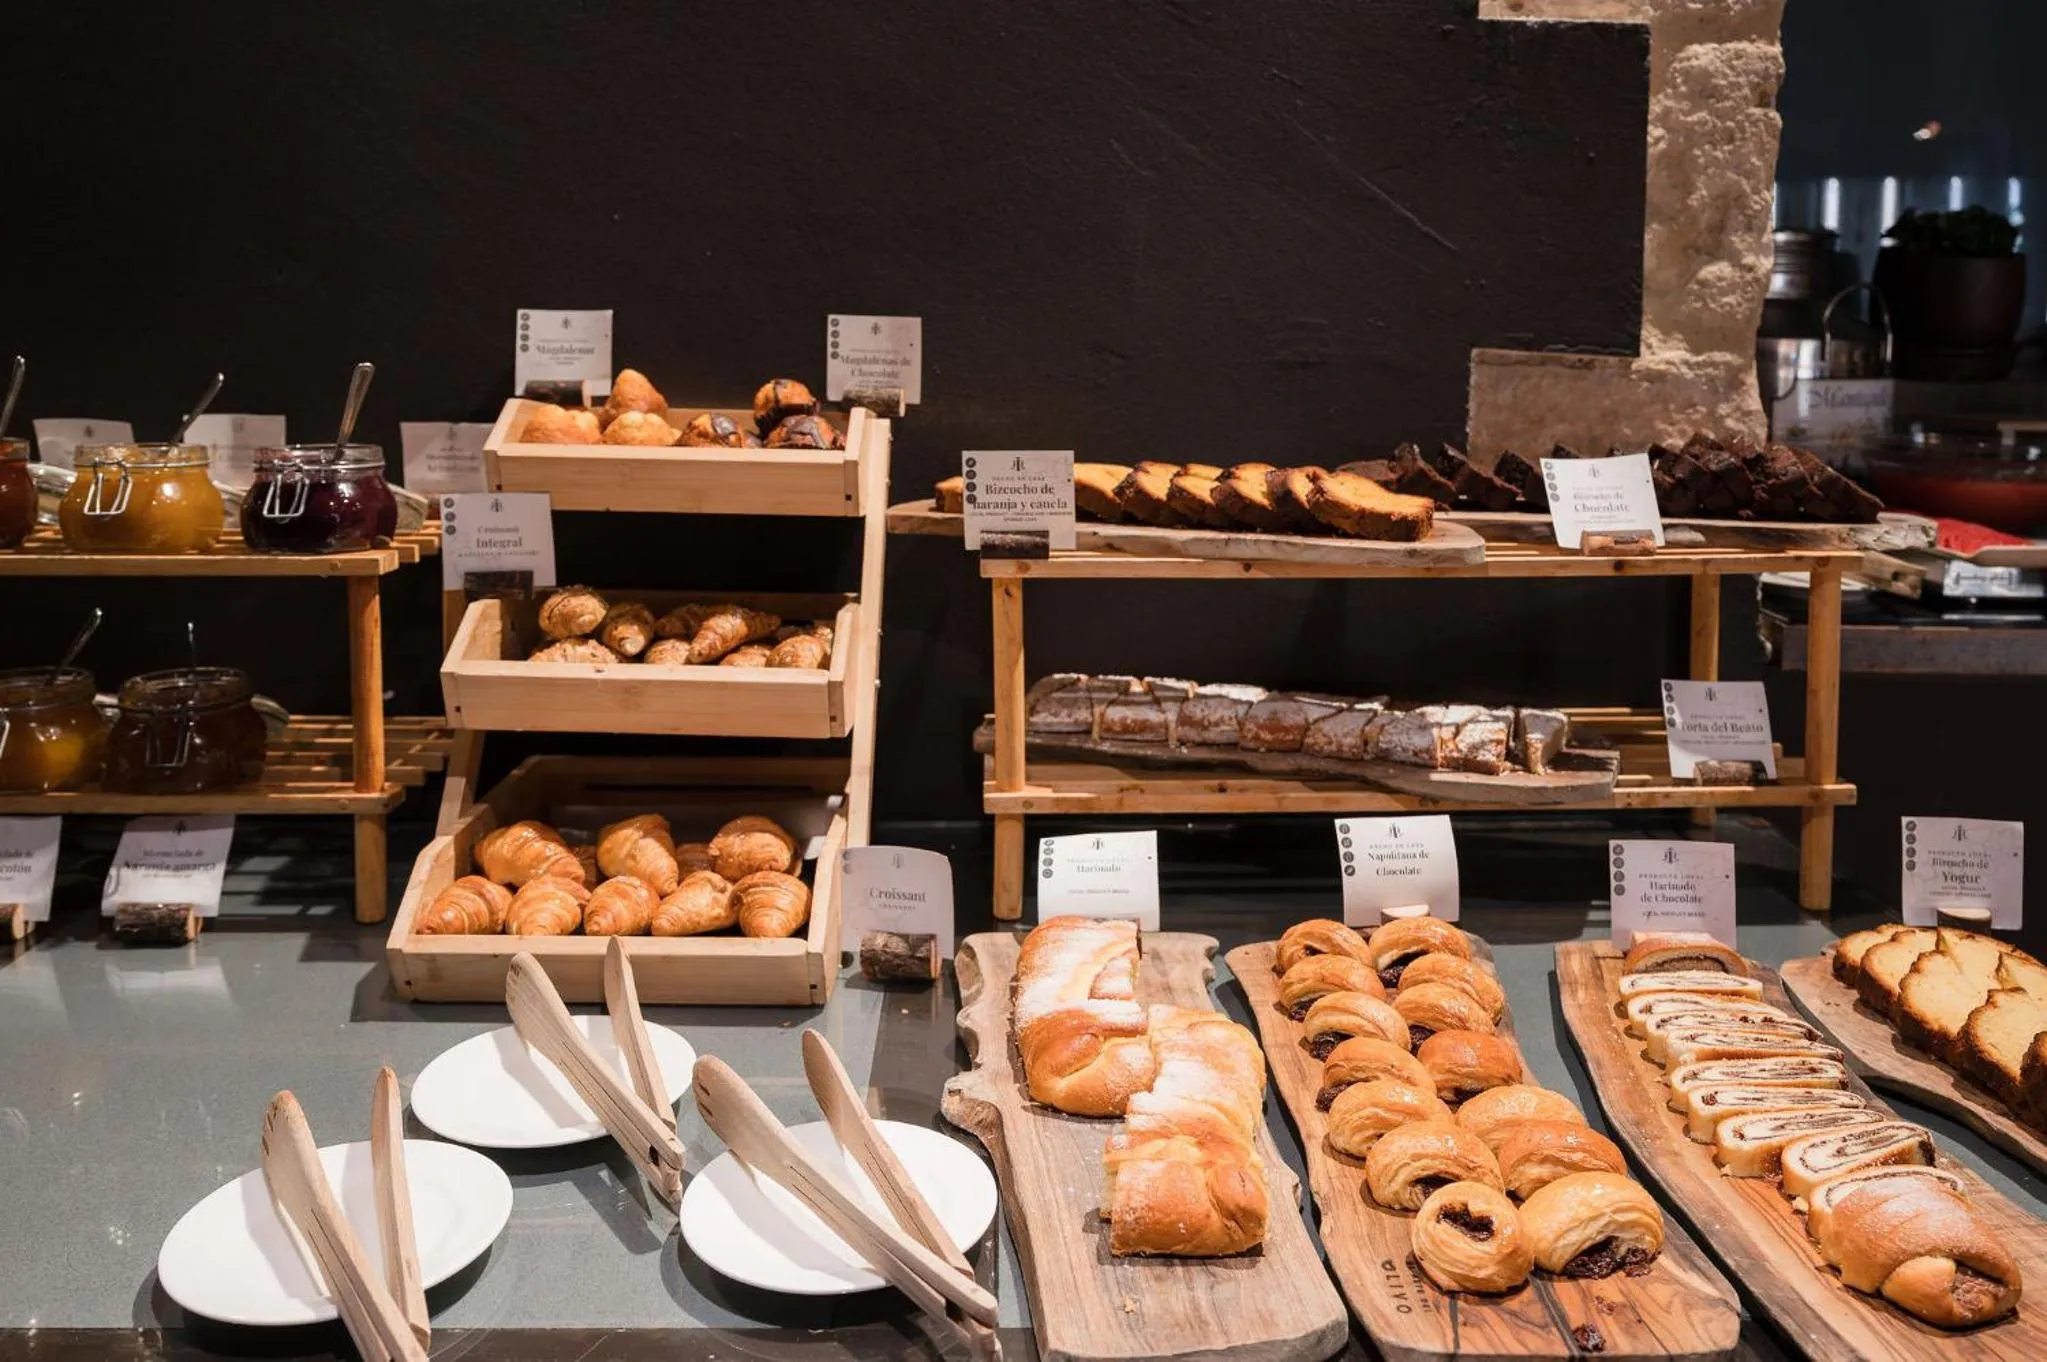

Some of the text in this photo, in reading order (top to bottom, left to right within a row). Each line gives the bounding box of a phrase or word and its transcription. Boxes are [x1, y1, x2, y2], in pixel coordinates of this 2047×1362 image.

[985, 483, 1055, 495] Bizcocho de
[973, 499, 1067, 512] naranja y canela
[476, 535, 522, 548] Integral
[1711, 722, 1728, 732] del
[1731, 723, 1764, 732] Beato
[1368, 850, 1429, 861] Napolitana de
[1932, 858, 1989, 869] Bizcocho de
[1376, 866, 1421, 877] Chocolate
[1942, 871, 1980, 885] Yogur
[1650, 881, 1696, 891] Harinado
[869, 887, 926, 902] Croissant
[1640, 892, 1703, 903] de Chocolate
[1381, 1259, 1412, 1313] OLIVO
